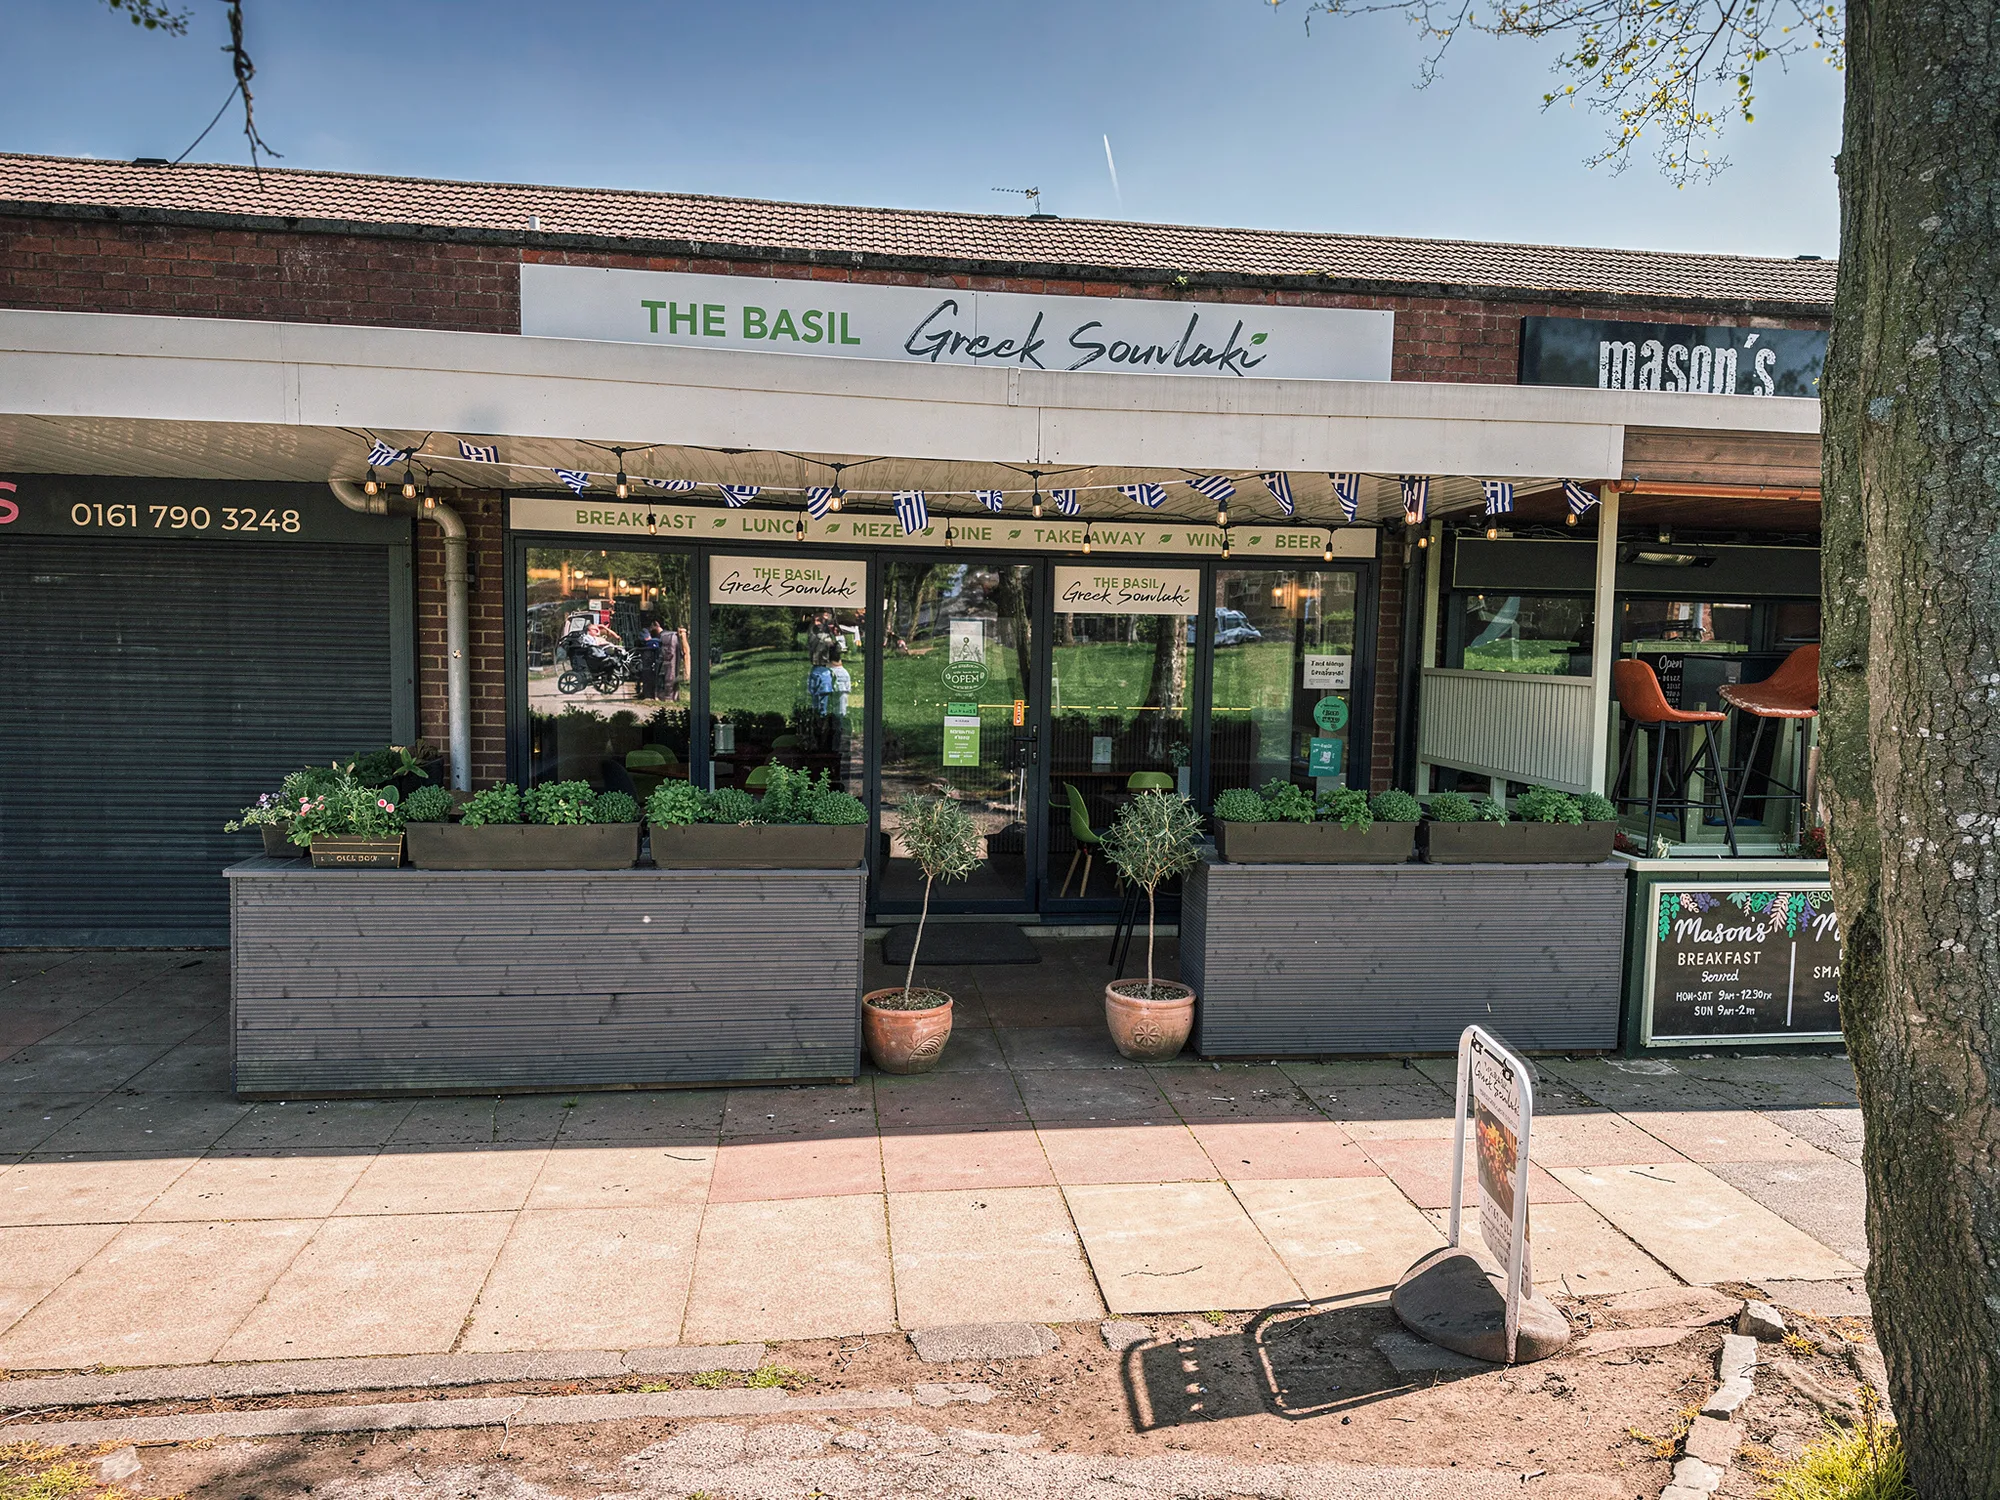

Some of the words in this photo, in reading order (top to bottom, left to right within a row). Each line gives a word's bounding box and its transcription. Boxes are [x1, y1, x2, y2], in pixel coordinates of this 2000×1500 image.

[641, 300, 726, 337] THE
[743, 306, 860, 345] BASIL
[903, 299, 1046, 370] Greek
[1066, 311, 1268, 377] Souvlaki
[70, 503, 138, 527] 0161
[149, 505, 211, 530] 790
[221, 507, 302, 533] 3248
[853, 522, 904, 538] MEZE
[1186, 533, 1236, 548] WINE
[1275, 534, 1322, 549] BEER
[753, 567, 780, 580] THE
[785, 568, 824, 581] BASIL
[1093, 577, 1118, 588] THE
[1123, 577, 1159, 589] BASIL
[719, 570, 774, 597] Greek
[778, 574, 858, 600] Souvlaki
[1062, 581, 1112, 605] Greek
[1116, 582, 1190, 607] Souvlaki
[951, 674, 979, 684] OPEN
[1674, 915, 1773, 945] Mason's
[1677, 950, 1762, 966] BREAKFAST
[1701, 968, 1740, 983] Served
[1813, 965, 1841, 979] SMA
[1693, 1005, 1714, 1017] SUN
